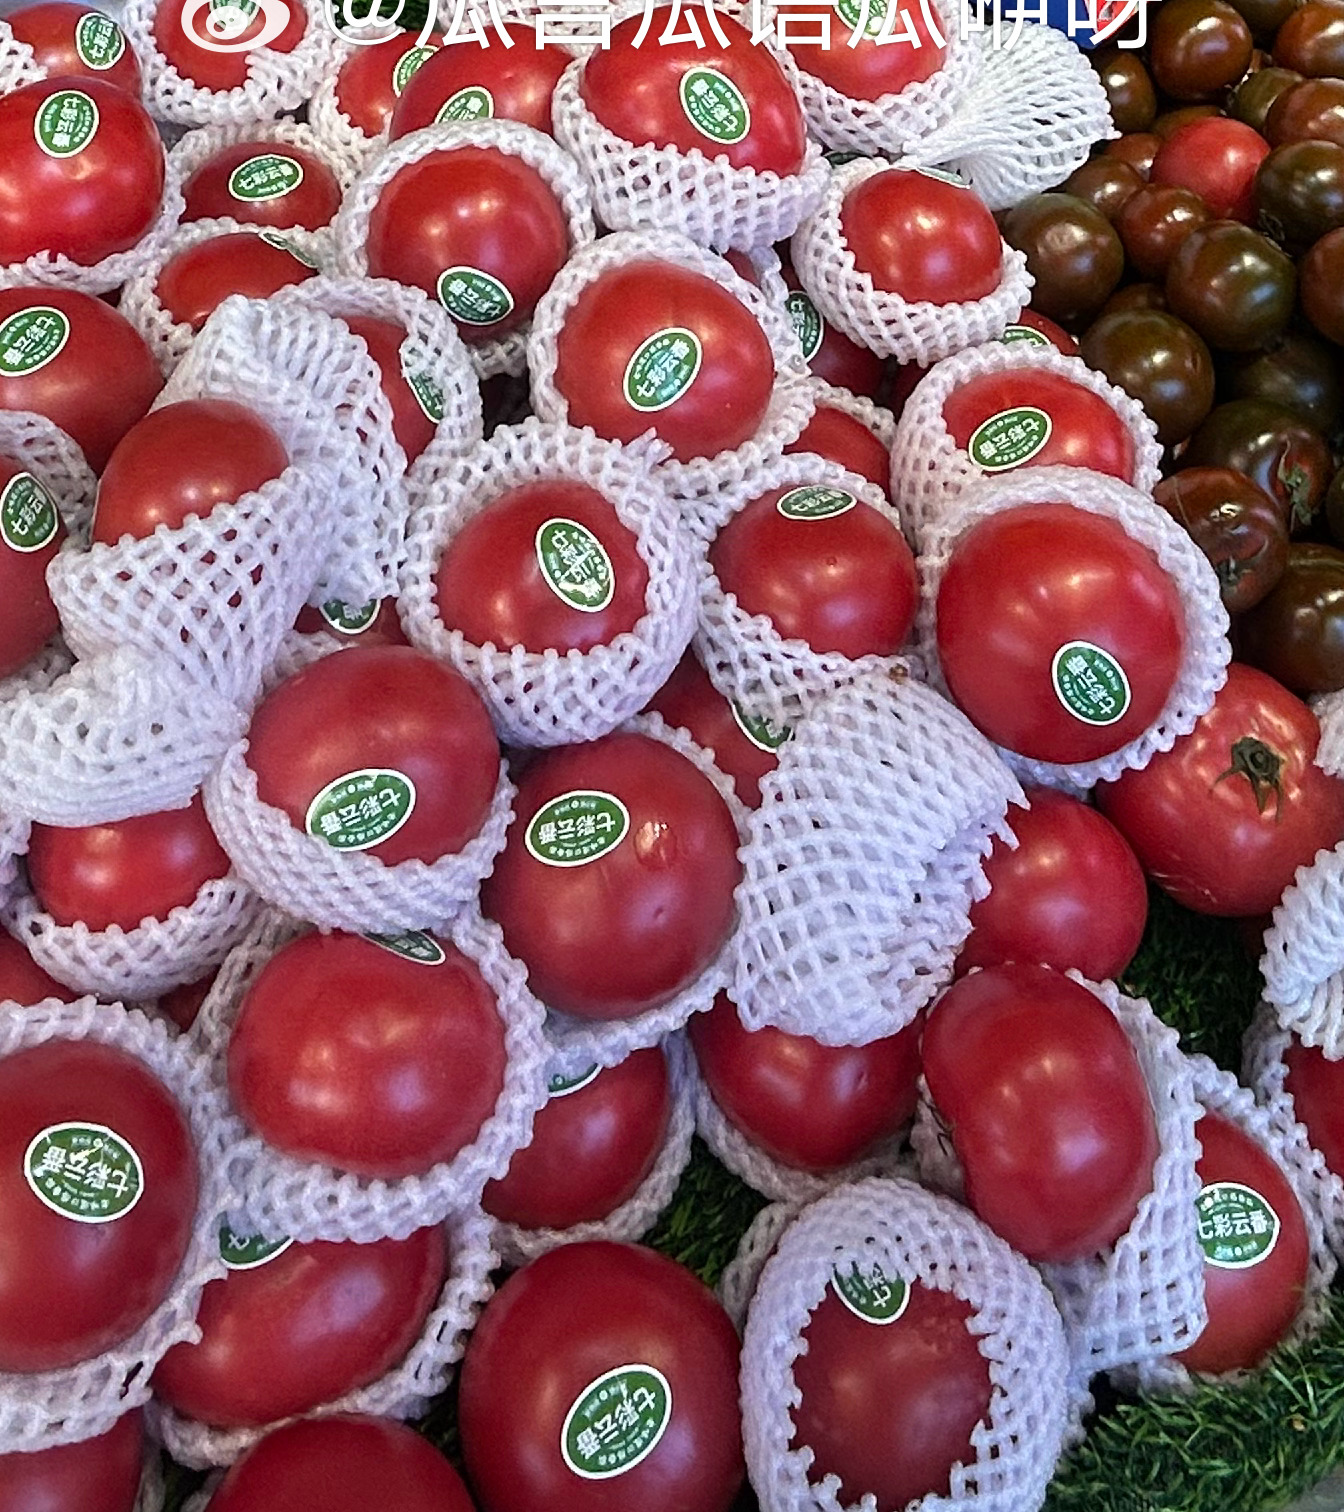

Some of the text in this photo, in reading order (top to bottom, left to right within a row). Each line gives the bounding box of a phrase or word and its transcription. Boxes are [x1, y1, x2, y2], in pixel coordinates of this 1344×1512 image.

[51, 96, 82, 149] 七彩云番
[690, 78, 738, 133] 七彩云番
[2, 315, 57, 366] 七彩云番
[636, 328, 690, 399] 七彩云番
[979, 418, 1040, 461] 七彩云番
[1064, 654, 1115, 715] 七彩云番
[319, 788, 402, 835] 七彩云番
[539, 811, 616, 846] 七彩云番
[35, 1145, 129, 1198] 七彩云番
[1198, 1209, 1268, 1241] 七彩云番
[576, 1387, 657, 1461] 七彩云番
